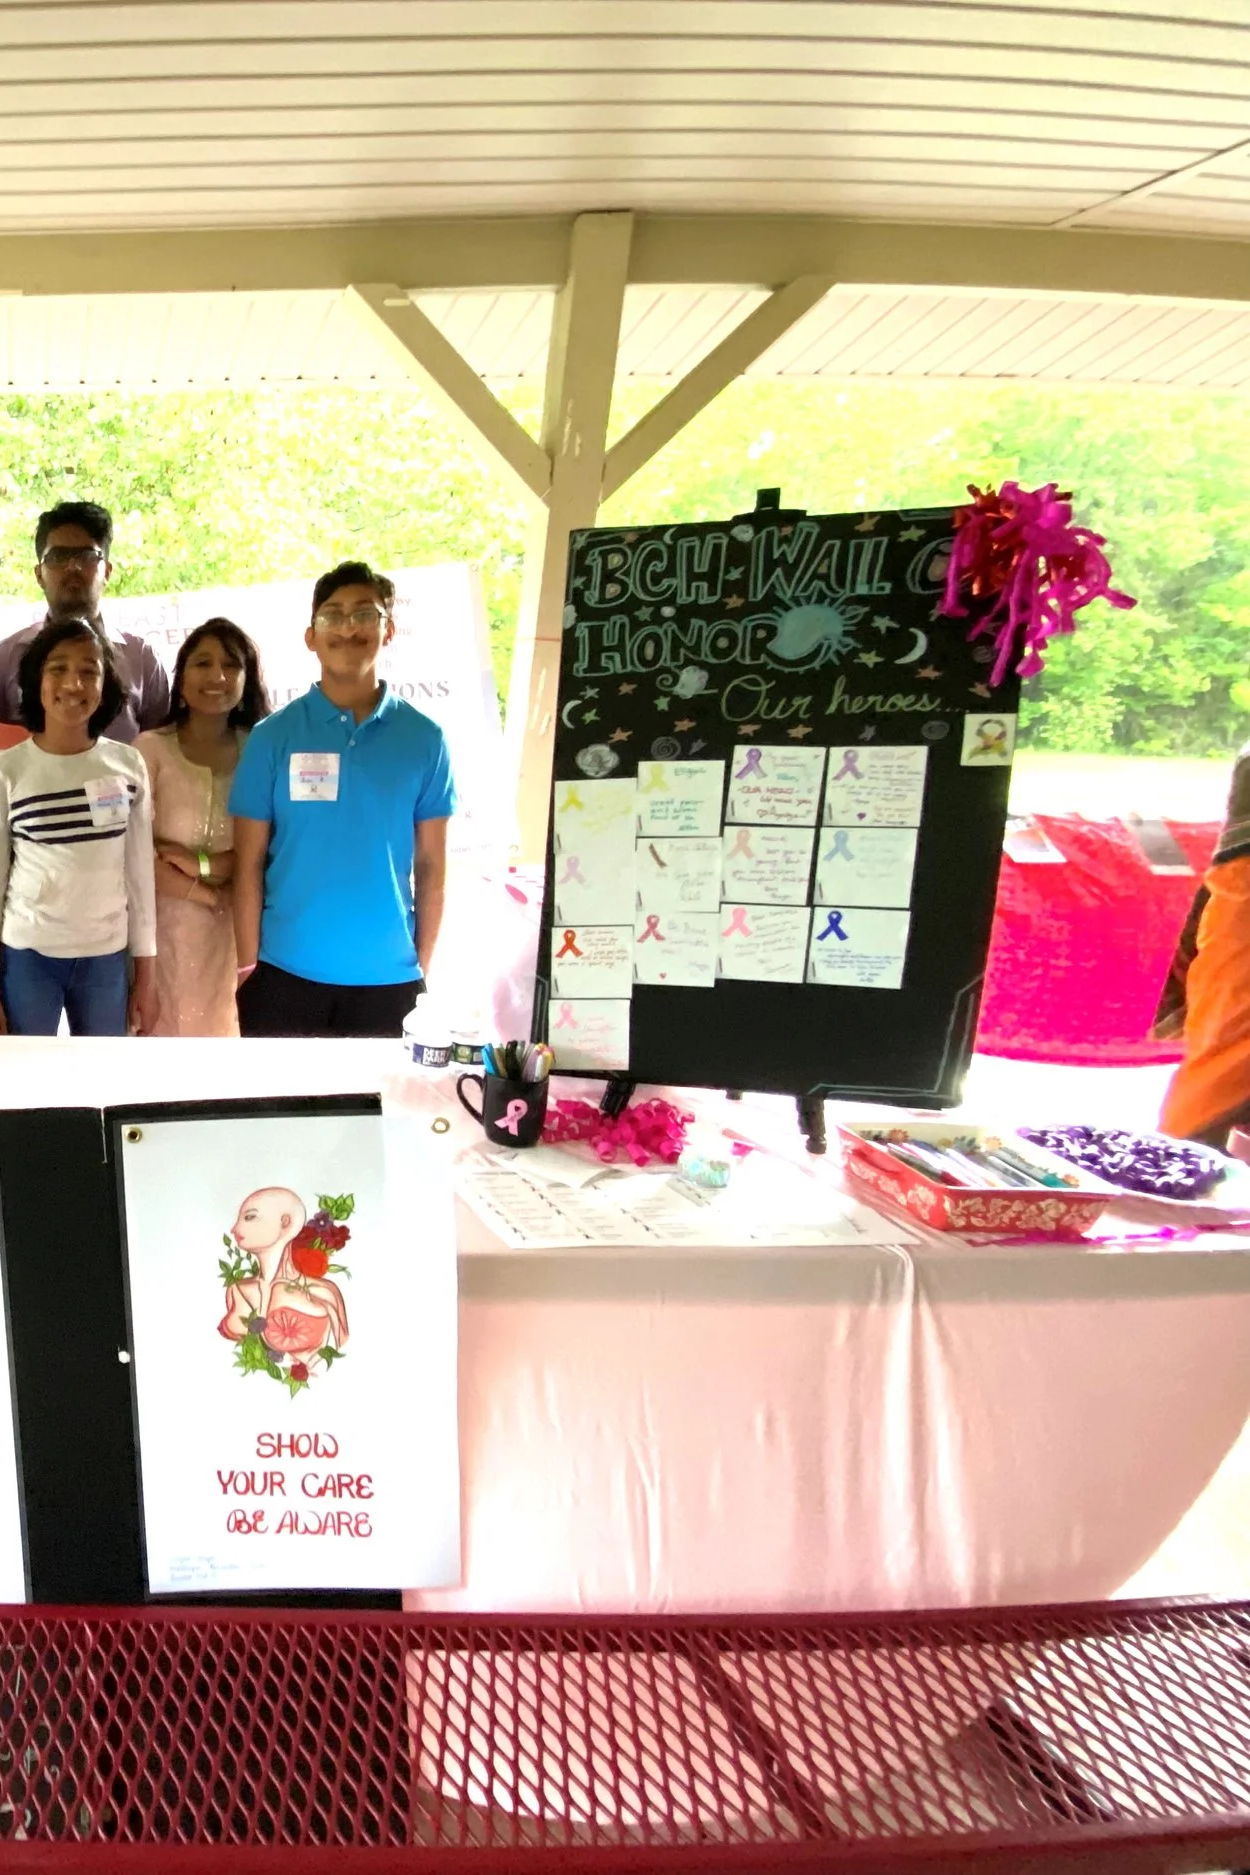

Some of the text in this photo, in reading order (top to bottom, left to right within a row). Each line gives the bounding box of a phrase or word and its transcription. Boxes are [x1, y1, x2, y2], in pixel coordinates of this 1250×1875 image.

[583, 532, 729, 609] BCH
[748, 520, 893, 602] WALL
[572, 613, 785, 677] HONOR
[720, 674, 814, 722] Our
[255, 1432, 339, 1459] SHOW
[216, 1469, 375, 1500] YOUR CARE
[226, 1508, 373, 1539] BE AWARE
